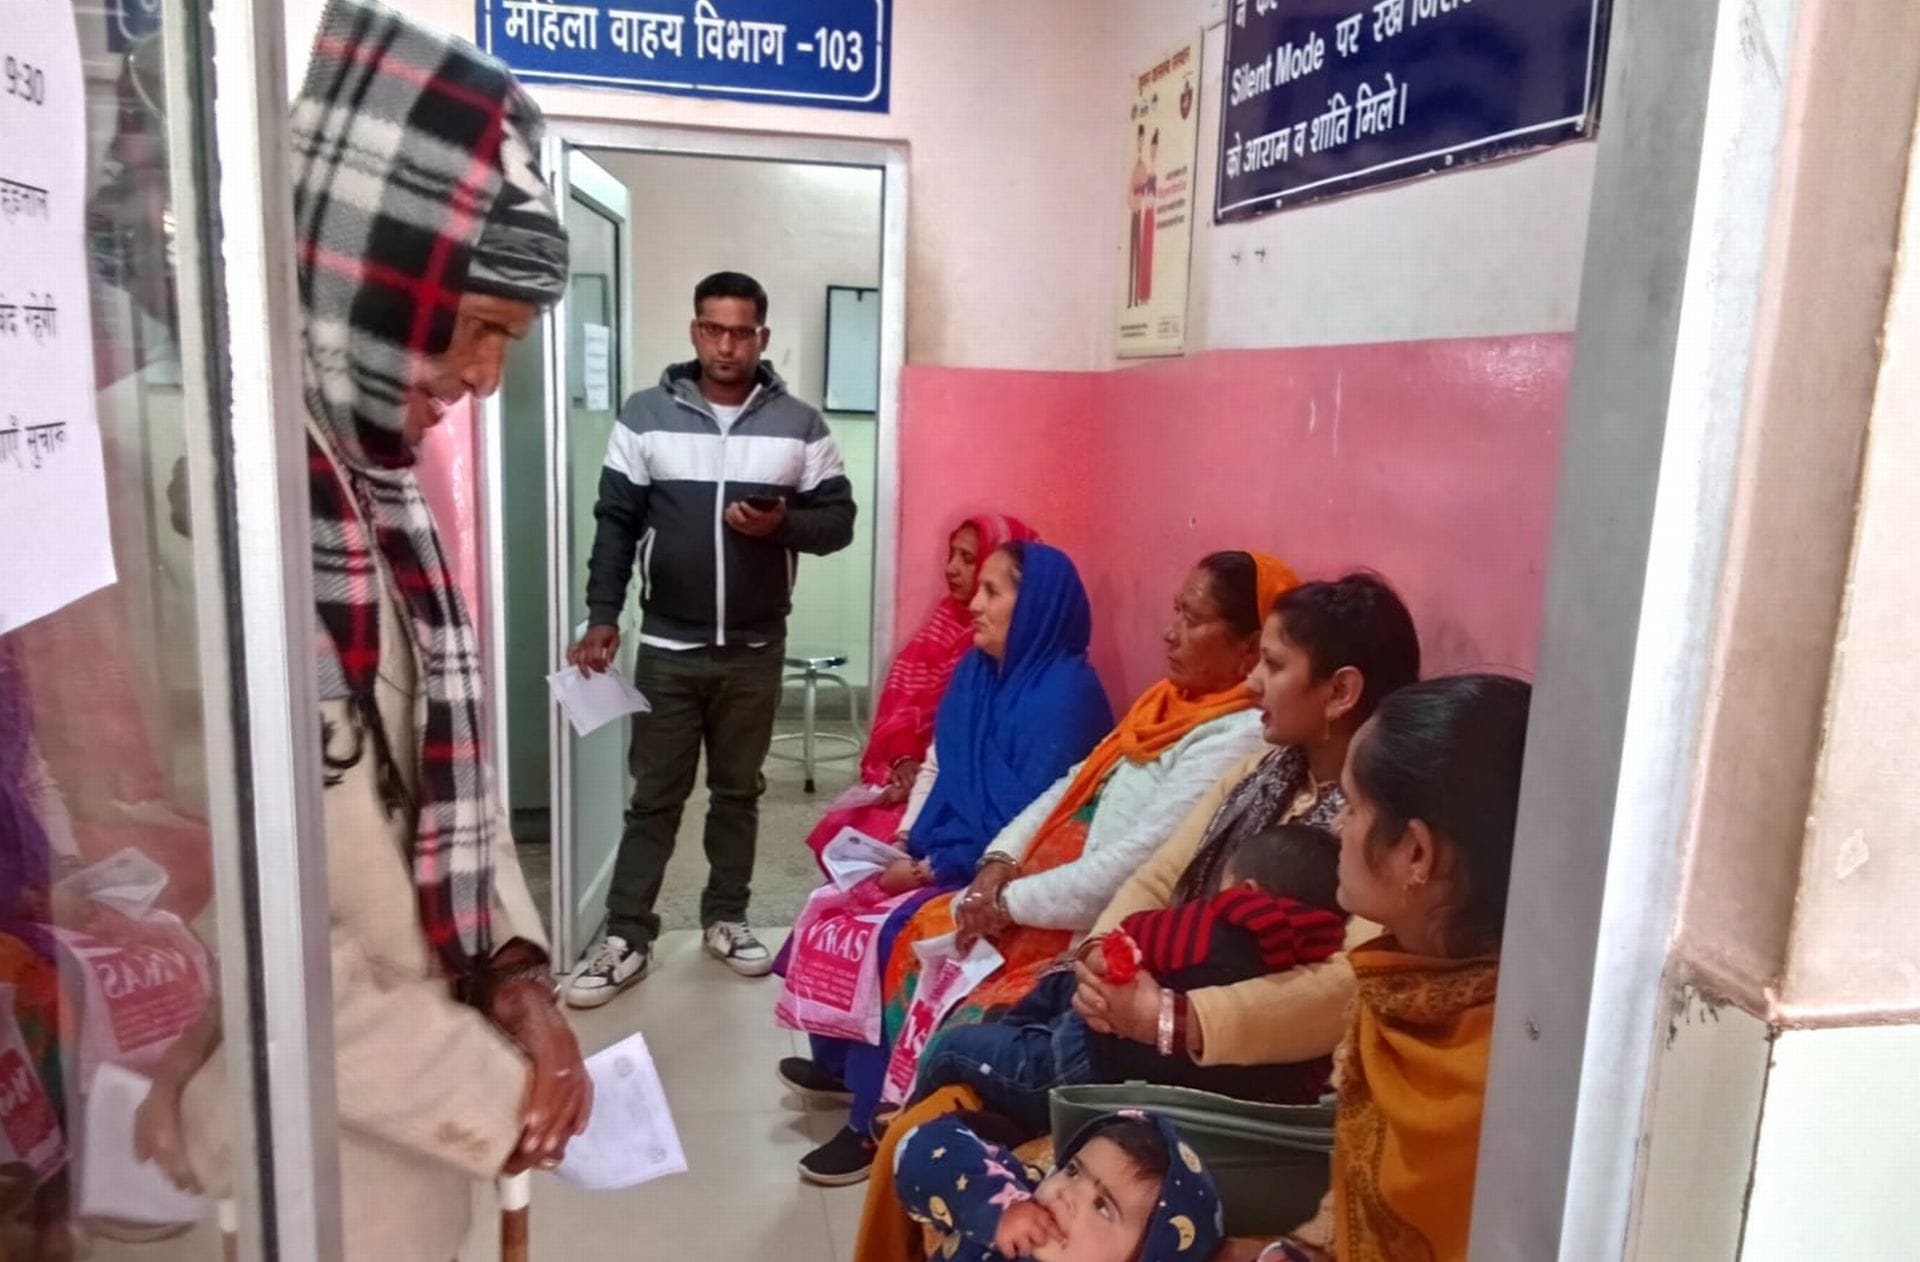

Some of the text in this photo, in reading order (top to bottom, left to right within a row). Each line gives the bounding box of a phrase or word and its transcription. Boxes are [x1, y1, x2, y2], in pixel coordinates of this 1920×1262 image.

[694, 0, 786, 65] विभाग
[1230, 54, 1271, 105] Silent
[1275, 32, 1325, 86] Mode
[1335, 13, 1362, 57] पर
[1226, 131, 1241, 178] को
[1243, 128, 1291, 173] आराम
[1293, 122, 1307, 157] व
[1310, 92, 1351, 153] शांति
